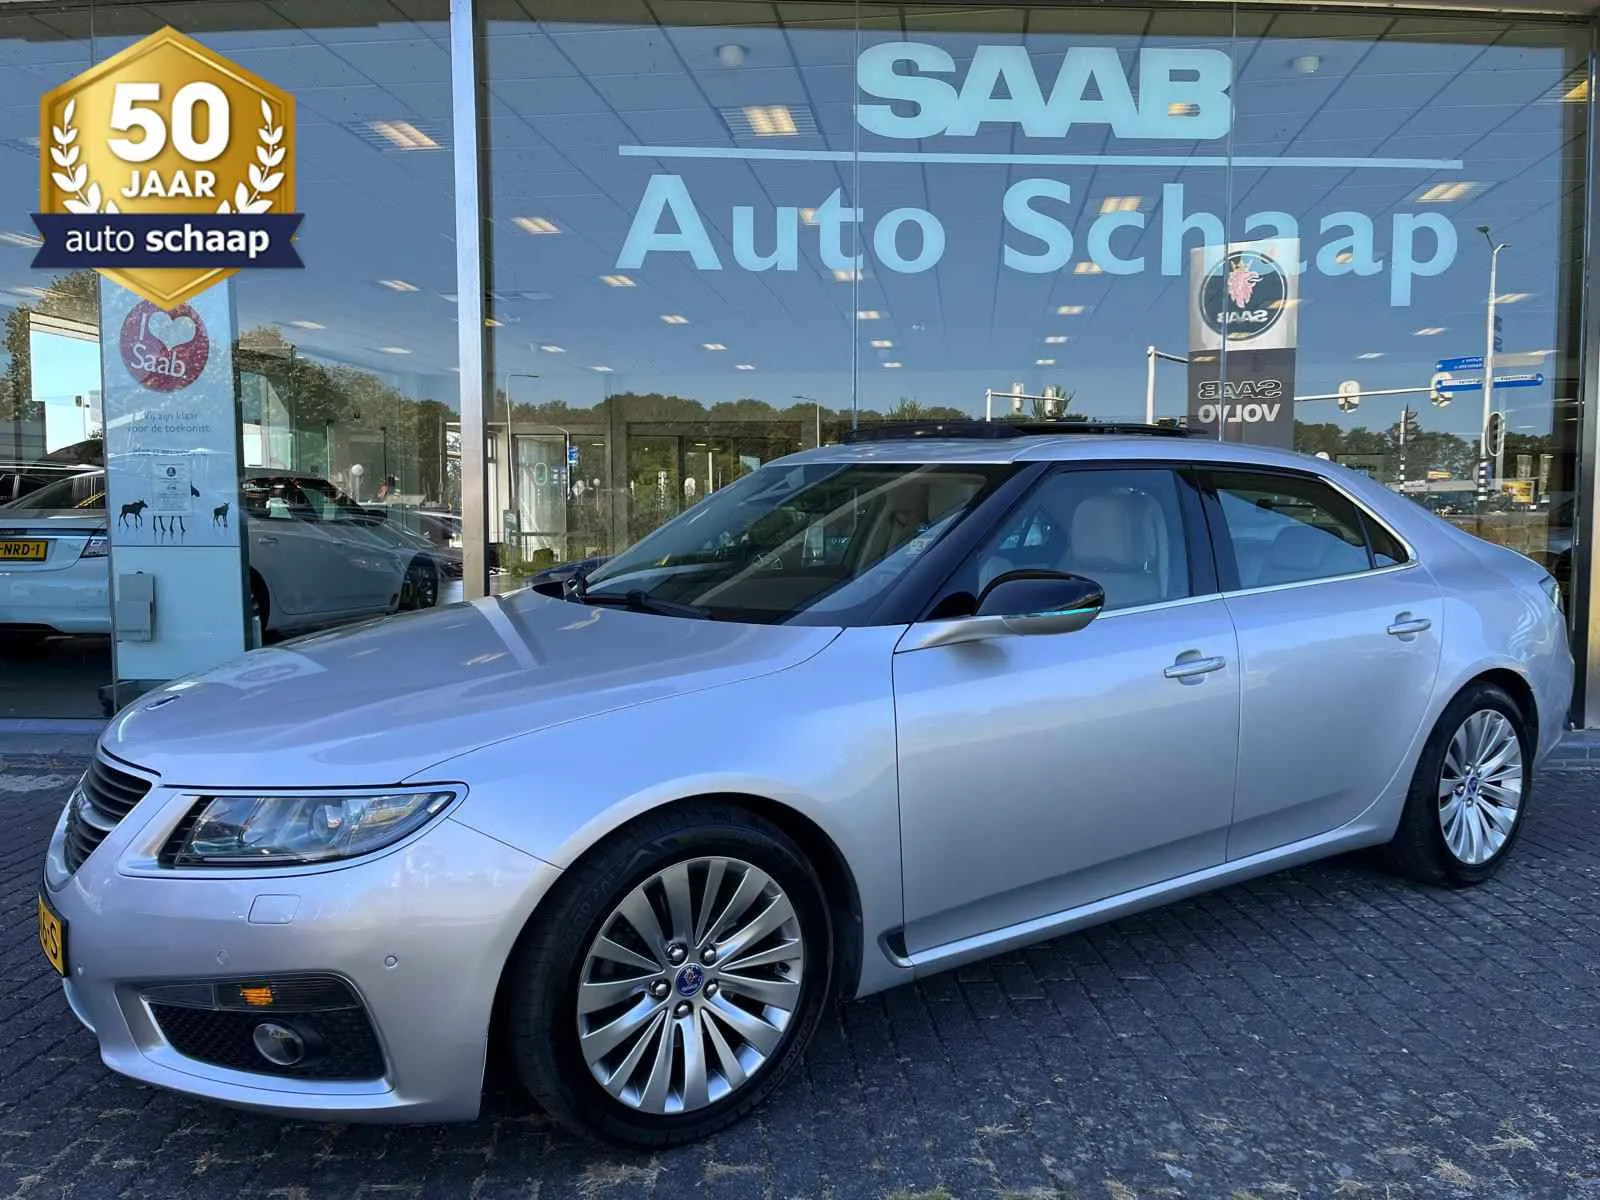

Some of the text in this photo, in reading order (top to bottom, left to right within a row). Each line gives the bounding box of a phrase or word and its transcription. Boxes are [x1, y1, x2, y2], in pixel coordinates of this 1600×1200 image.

[856, 42, 1235, 140] SAAB
[616, 174, 1458, 307] Auto Schaap
[139, 312, 147, 341] I
